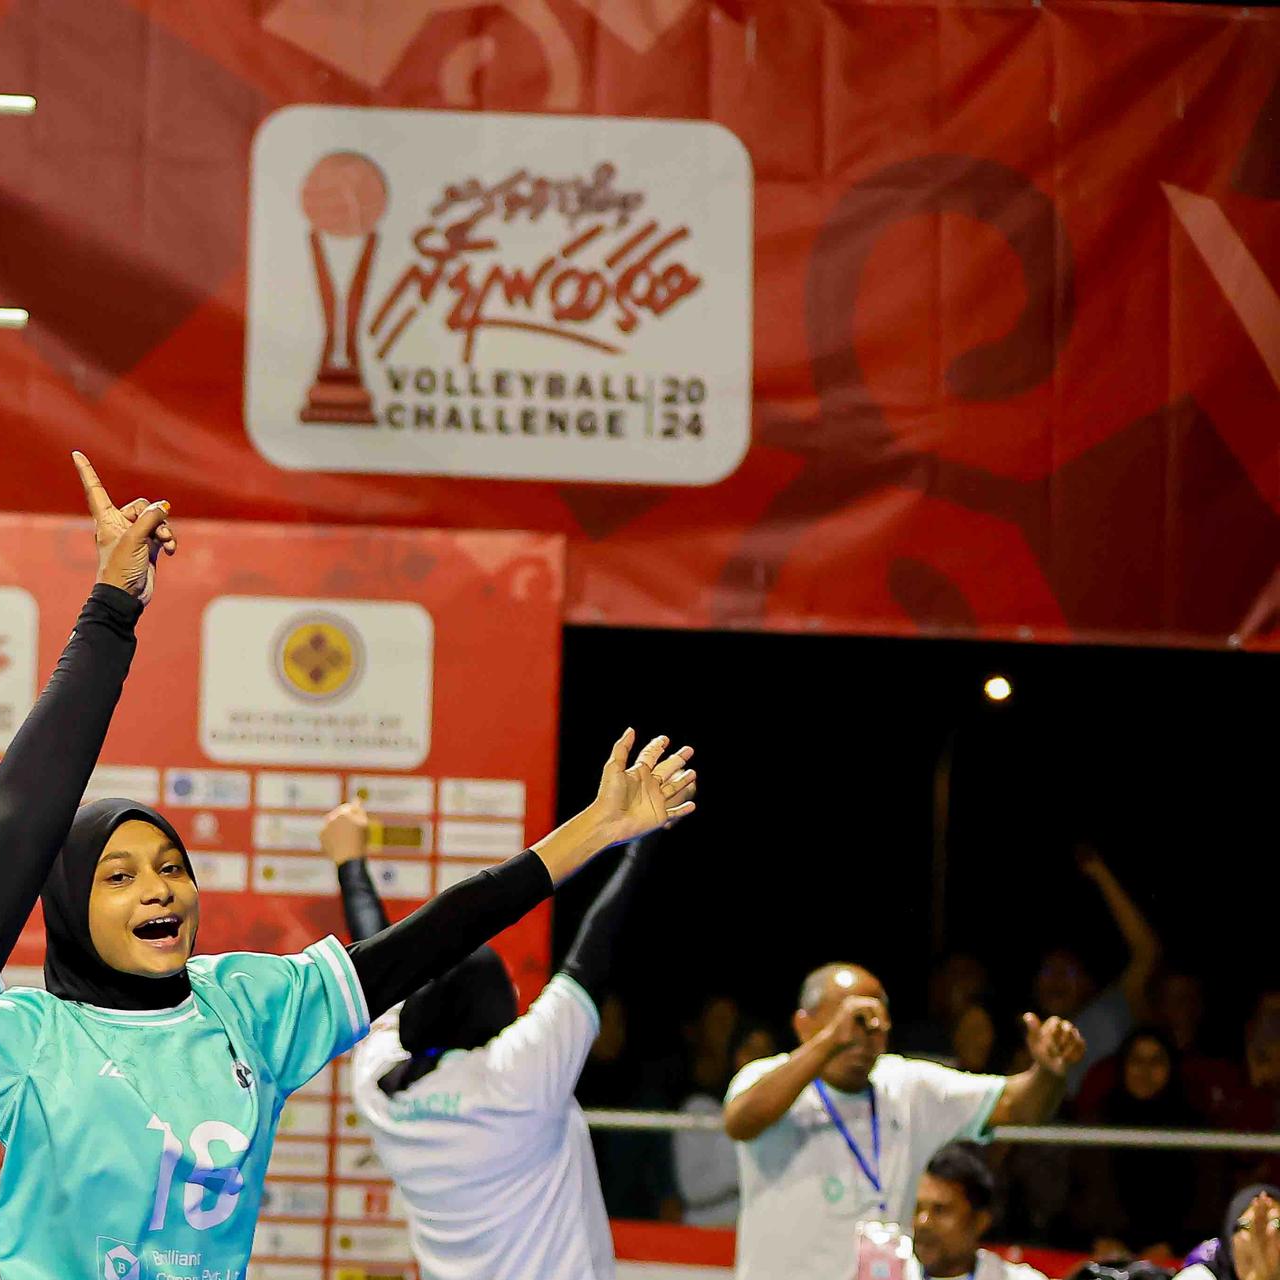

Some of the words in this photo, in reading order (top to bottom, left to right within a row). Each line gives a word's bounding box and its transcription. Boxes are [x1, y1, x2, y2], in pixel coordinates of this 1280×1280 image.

[386, 365, 646, 402] VOLLEYBALL
[661, 375, 707, 404] 20
[385, 403, 625, 437] CHALLENGE
[658, 408, 706, 438] 24
